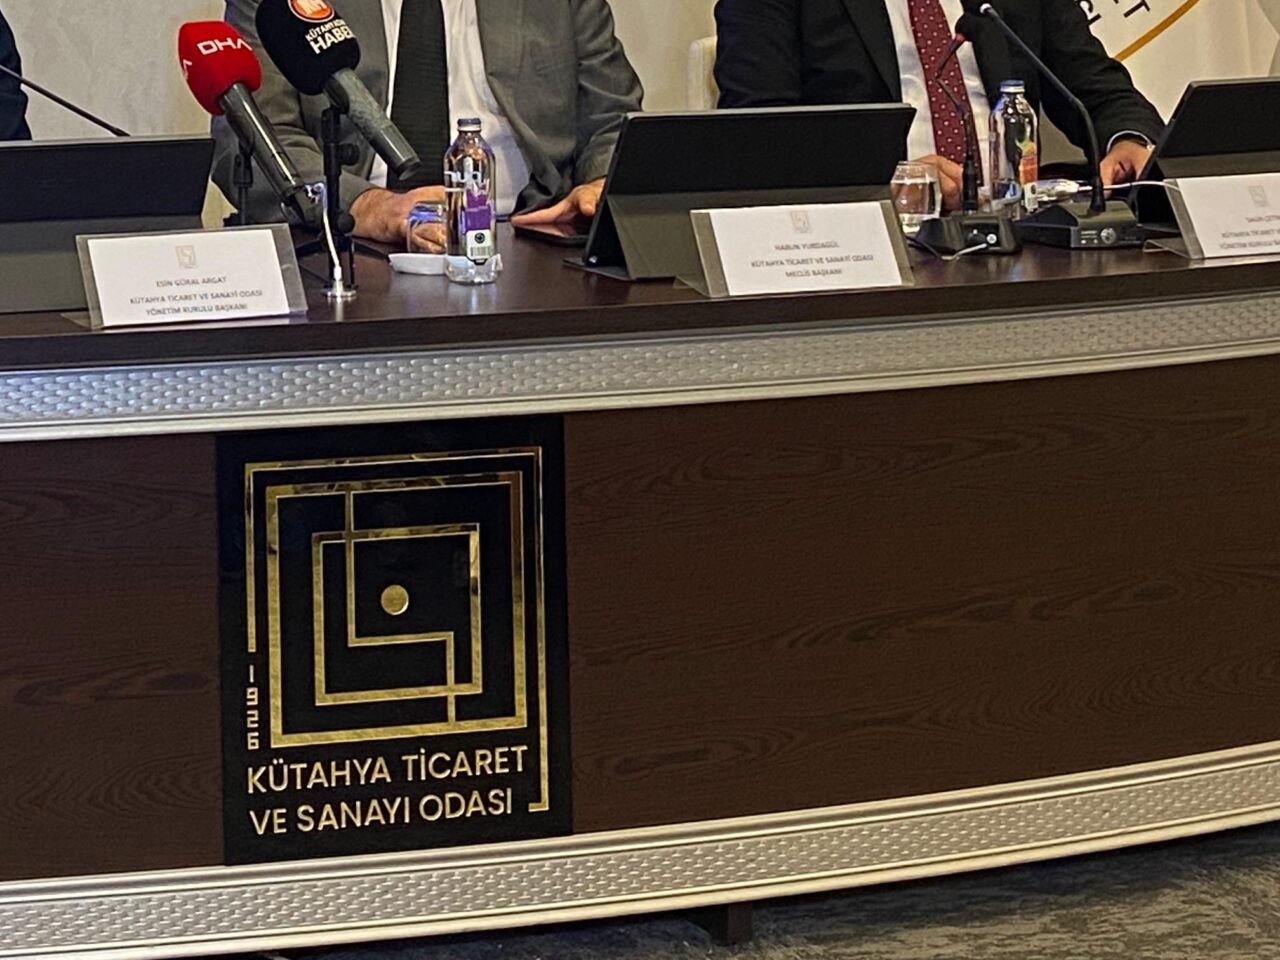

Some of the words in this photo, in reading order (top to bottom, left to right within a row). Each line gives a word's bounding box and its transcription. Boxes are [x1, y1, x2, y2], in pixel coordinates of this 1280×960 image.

[246, 664, 260, 751] 1926
[247, 757, 392, 794] KÜTAHYA
[401, 746, 528, 782] TİCARET
[249, 808, 287, 836] VE
[419, 787, 513, 822] ODASI
